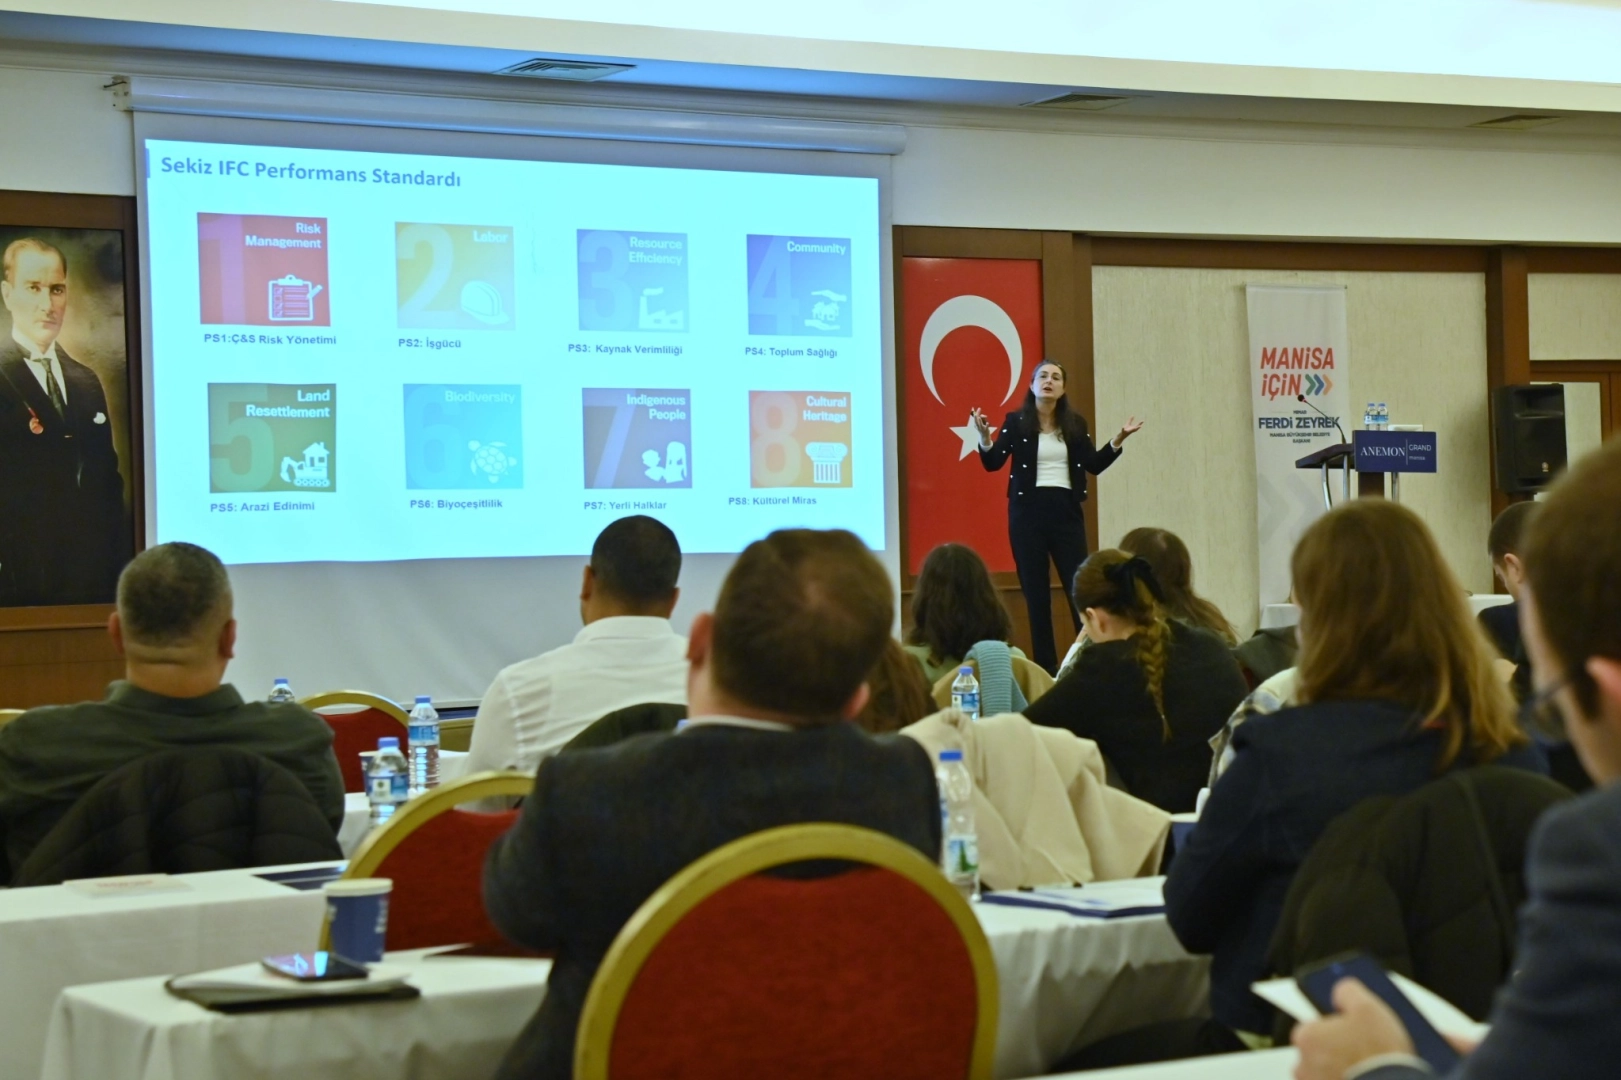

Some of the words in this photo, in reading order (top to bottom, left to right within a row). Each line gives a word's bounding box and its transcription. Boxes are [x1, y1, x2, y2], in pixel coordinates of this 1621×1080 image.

[161, 156, 213, 176] Sekiz
[218, 160, 250, 177] IFC
[255, 162, 367, 184] Performans
[372, 168, 462, 187] Standardı
[295, 222, 322, 235] Risk
[245, 235, 322, 250] Management
[473, 230, 508, 243] Labor
[629, 236, 683, 249] Resource
[786, 240, 846, 256] Community
[628, 252, 683, 266] Efficiency
[204, 333, 256, 347] PS1:Ç&S
[259, 334, 283, 345] Risk
[286, 334, 337, 345] Yönetimi
[398, 338, 422, 348] PS2:
[426, 337, 462, 350] İşgücü
[568, 344, 591, 353] PS3:
[595, 344, 632, 356] Kaynak
[634, 344, 683, 356] Verimliliği
[745, 347, 767, 356] PS4:
[769, 347, 804, 358] Toplum
[806, 347, 838, 358] Sağlığı
[297, 389, 331, 402] Land
[444, 390, 516, 404] Biodiversity
[626, 393, 686, 407] Indigenous
[806, 395, 847, 408] Cultural
[245, 404, 330, 418] Resettlement
[649, 409, 687, 422] People
[803, 410, 847, 423] Heritage
[1295, 416, 1340, 430] ZEYREK
[1360, 446, 1405, 457] ANEMON
[1408, 444, 1432, 452] GRAND
[210, 502, 238, 513] PS5:
[240, 501, 270, 512] Arazi
[273, 500, 315, 511] Edinimi
[410, 499, 434, 509] PS6:
[437, 498, 503, 511] Biyoçeşitlilik
[584, 501, 607, 511] PS7:
[609, 501, 631, 510] Yerli
[633, 500, 667, 510] Halklar
[728, 496, 751, 506] PS8:
[752, 495, 790, 506] Kültürel
[792, 496, 817, 505] Miras
